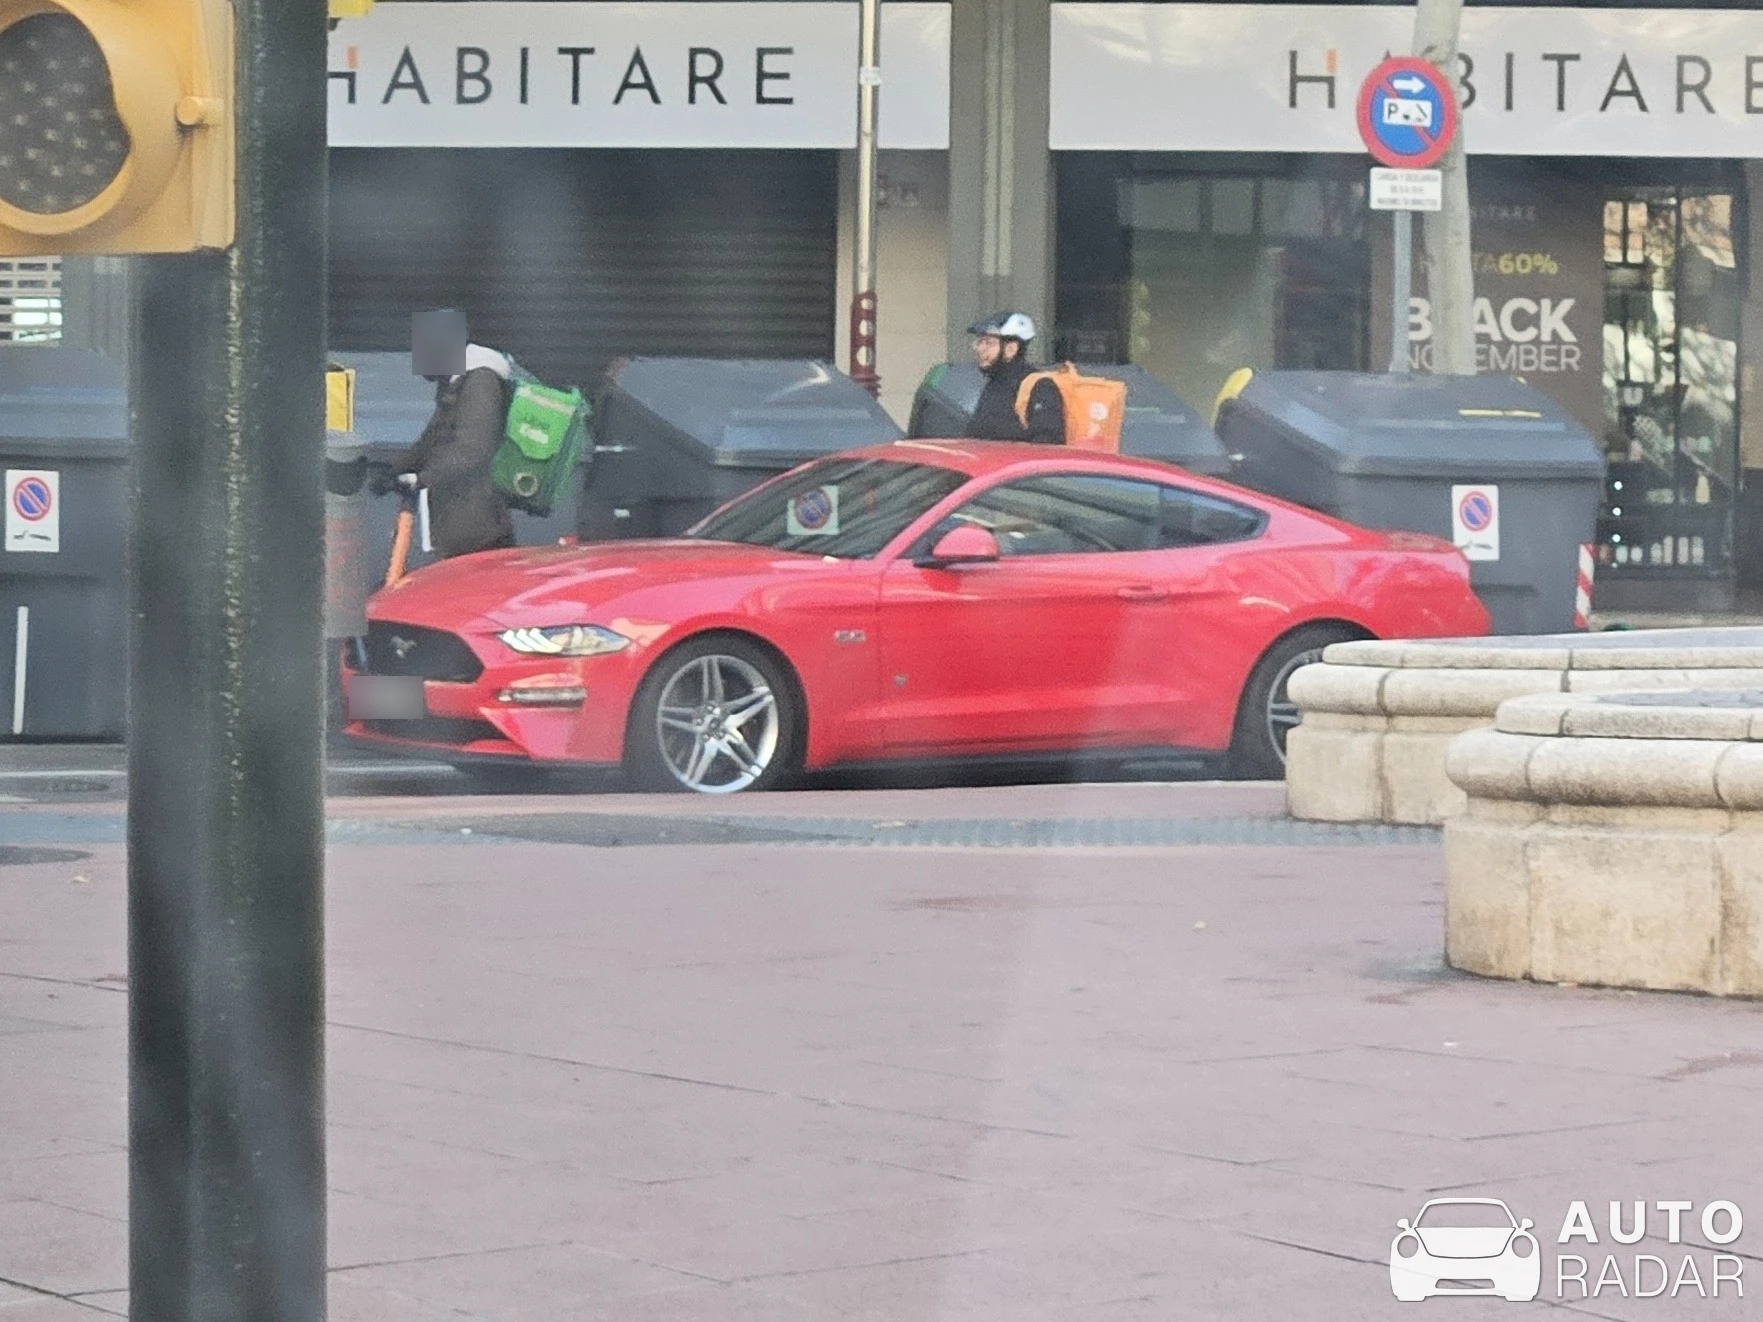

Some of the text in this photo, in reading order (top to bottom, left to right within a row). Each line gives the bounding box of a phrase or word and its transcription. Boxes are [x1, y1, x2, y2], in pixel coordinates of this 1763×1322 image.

[1289, 48, 1763, 115] HBITARE
[1388, 103, 1399, 120] P
[1408, 297, 1578, 343] BACK
